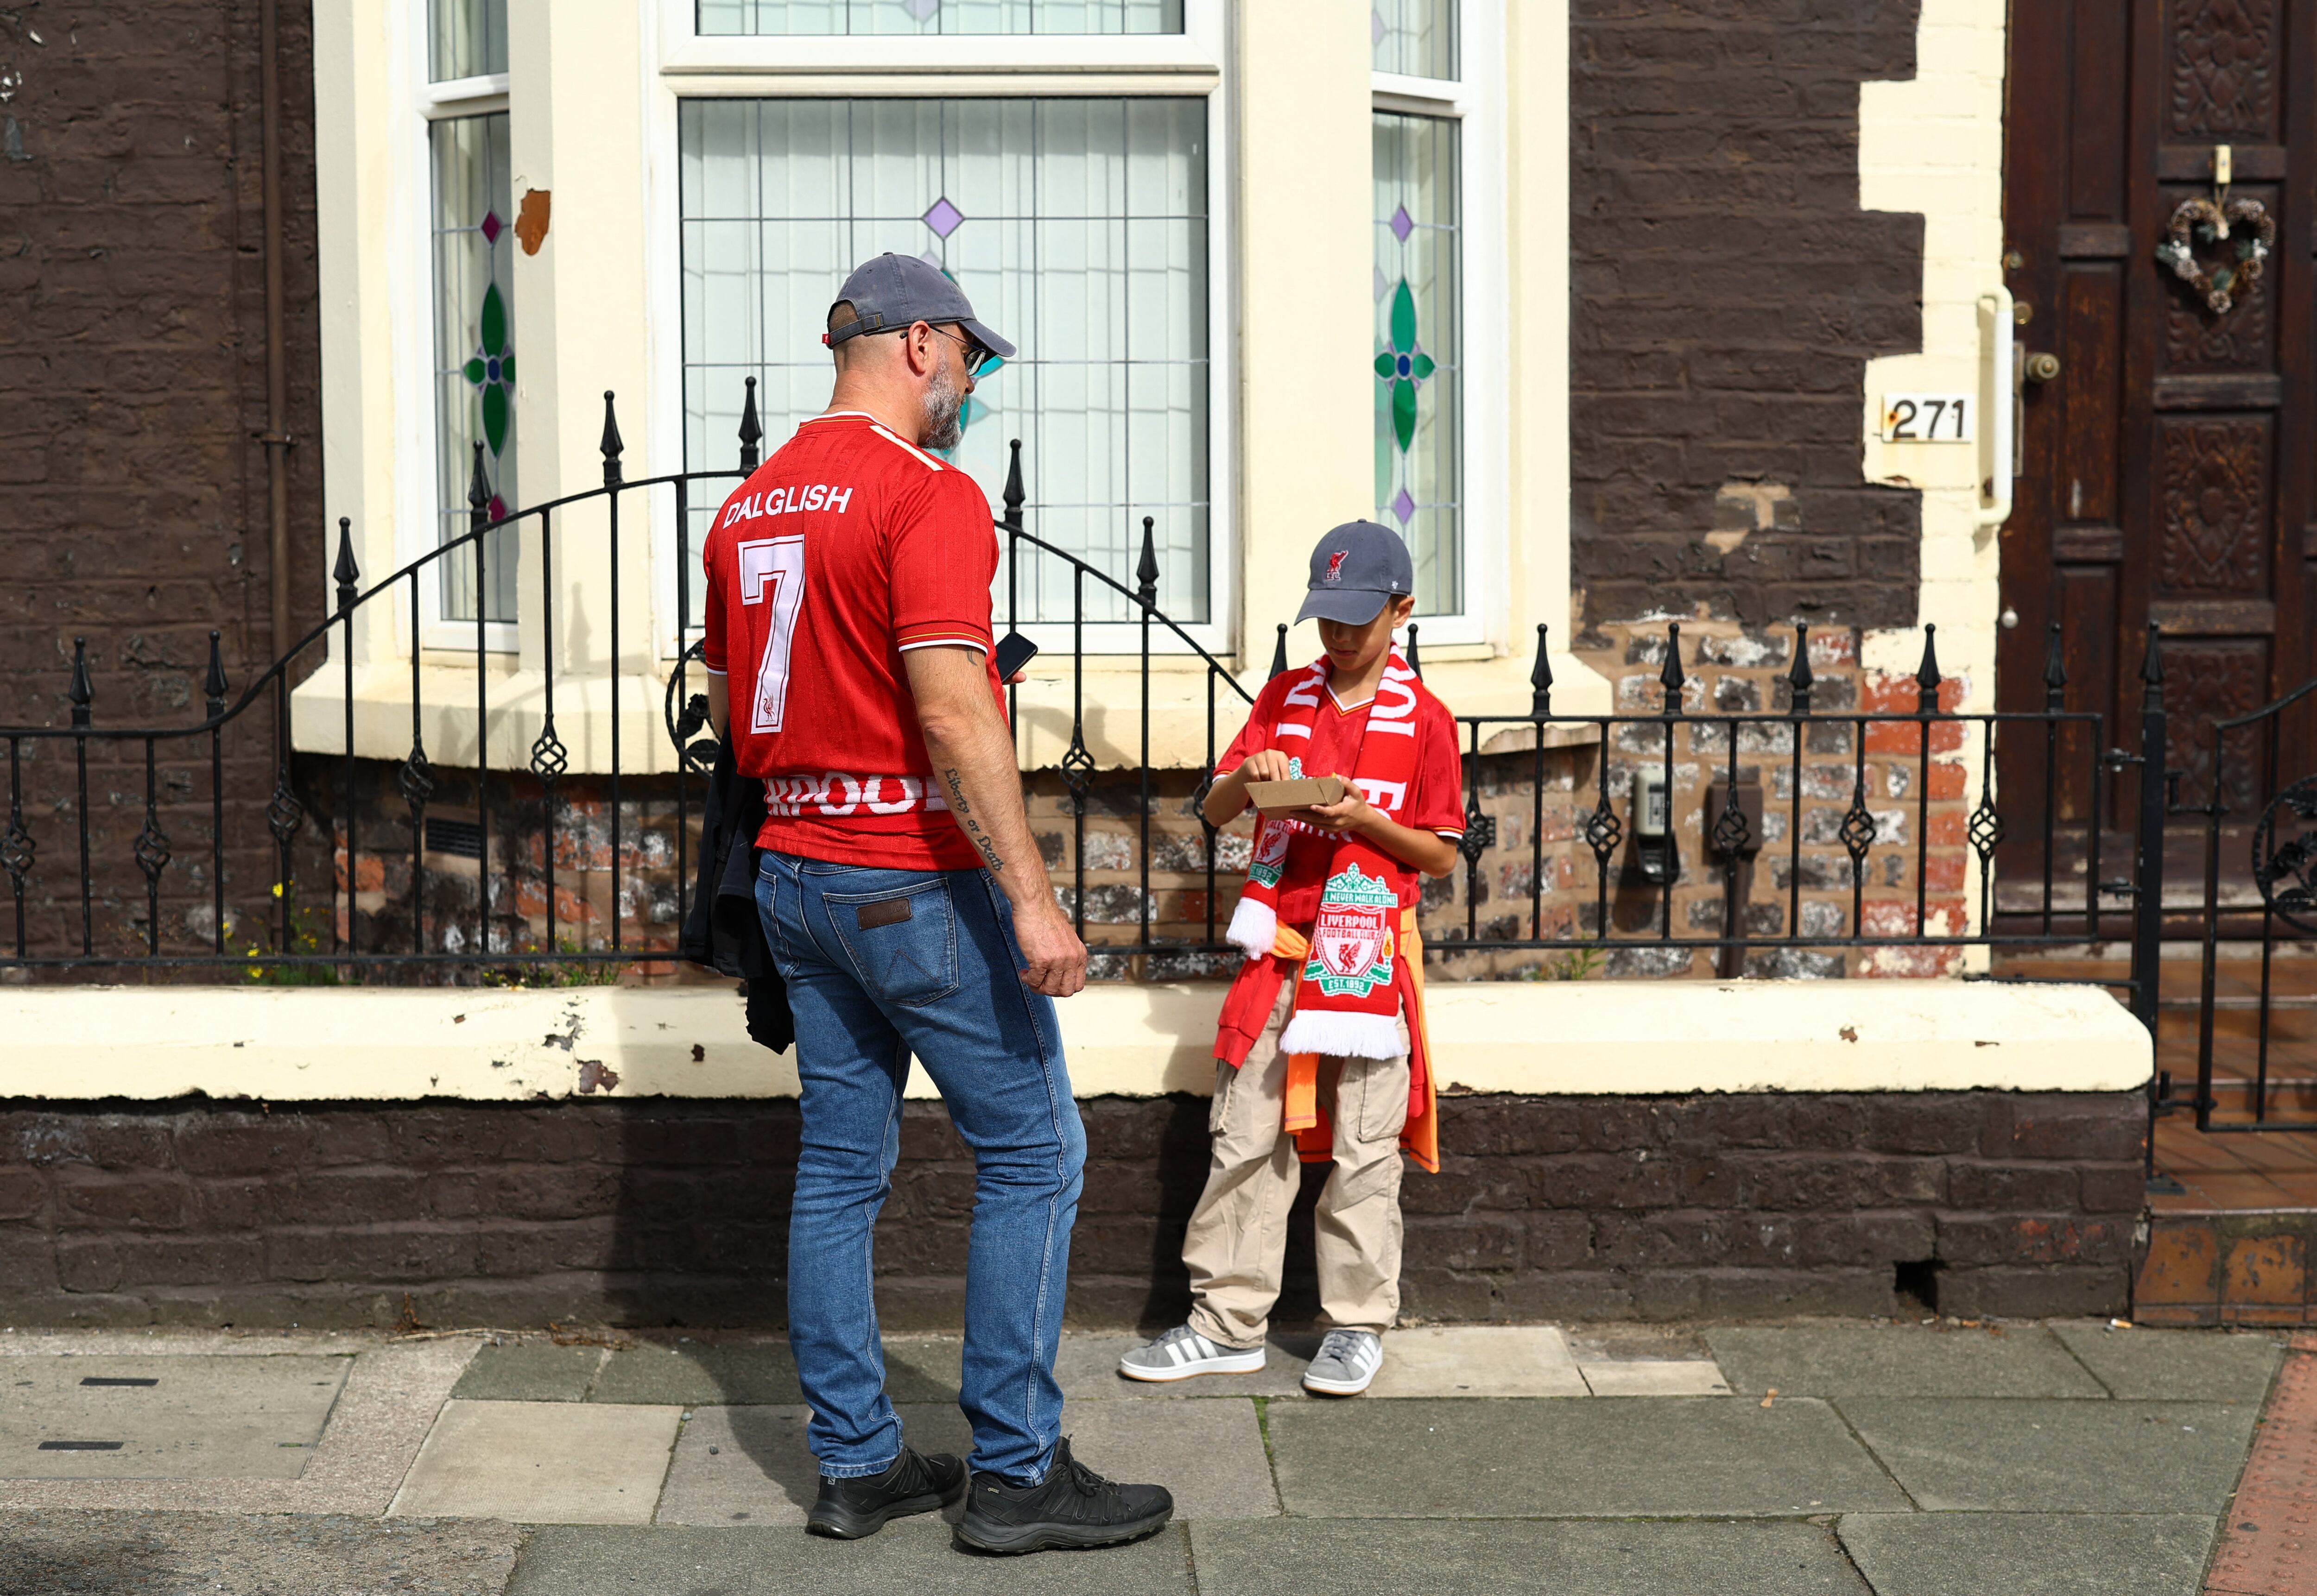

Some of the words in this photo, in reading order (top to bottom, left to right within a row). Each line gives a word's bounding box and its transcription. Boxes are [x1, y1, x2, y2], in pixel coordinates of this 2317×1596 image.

[1893, 400, 1964, 438] 271
[722, 484, 853, 530] DALGLISH
[737, 534, 805, 734] 7
[944, 768, 969, 814] Liberty
[968, 819, 981, 832] or
[977, 835, 1005, 871] Death
[1330, 892, 1353, 902] NEVER
[1355, 893, 1373, 903] WALK
[1374, 894, 1395, 905] ALONE
[1321, 914, 1378, 929] LIVERPOOL
[1323, 928, 1358, 939] FOOTBALL
[1360, 931, 1375, 940] CLUB
